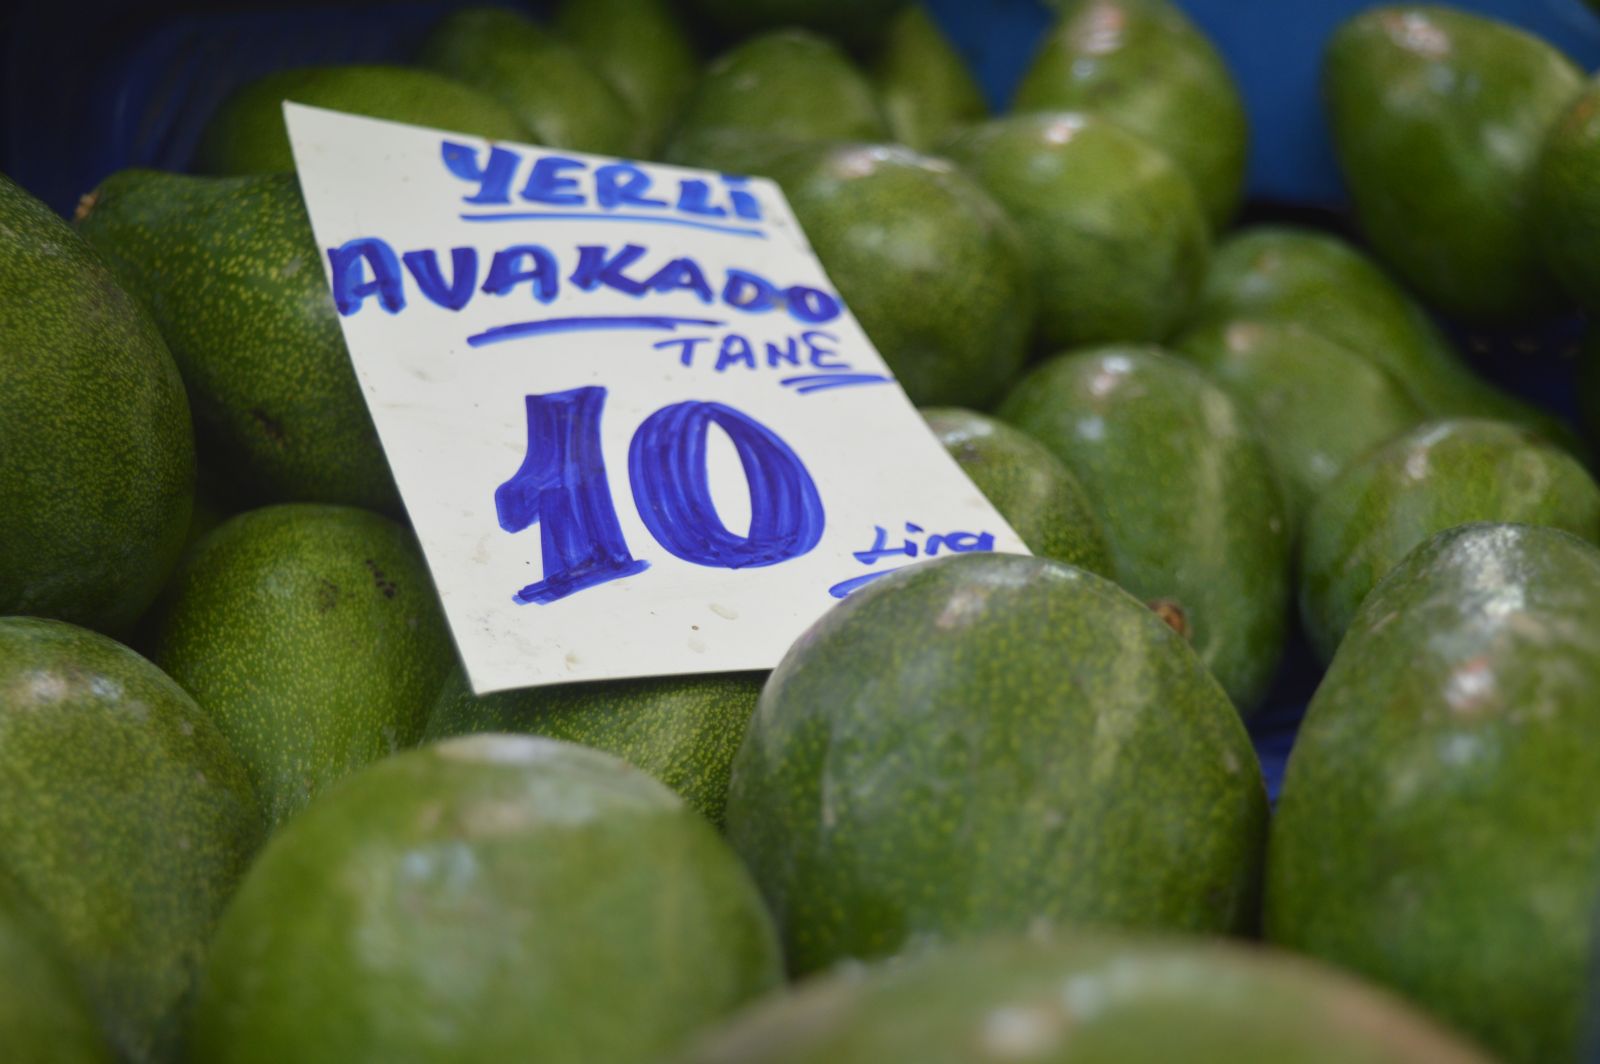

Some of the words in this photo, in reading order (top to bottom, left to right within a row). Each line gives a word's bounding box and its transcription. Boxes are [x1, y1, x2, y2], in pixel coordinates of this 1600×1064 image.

[329, 236, 845, 325] AVAKADO
[653, 332, 850, 372] TANE
[494, 385, 827, 606] 10
[853, 522, 997, 566] Lira
